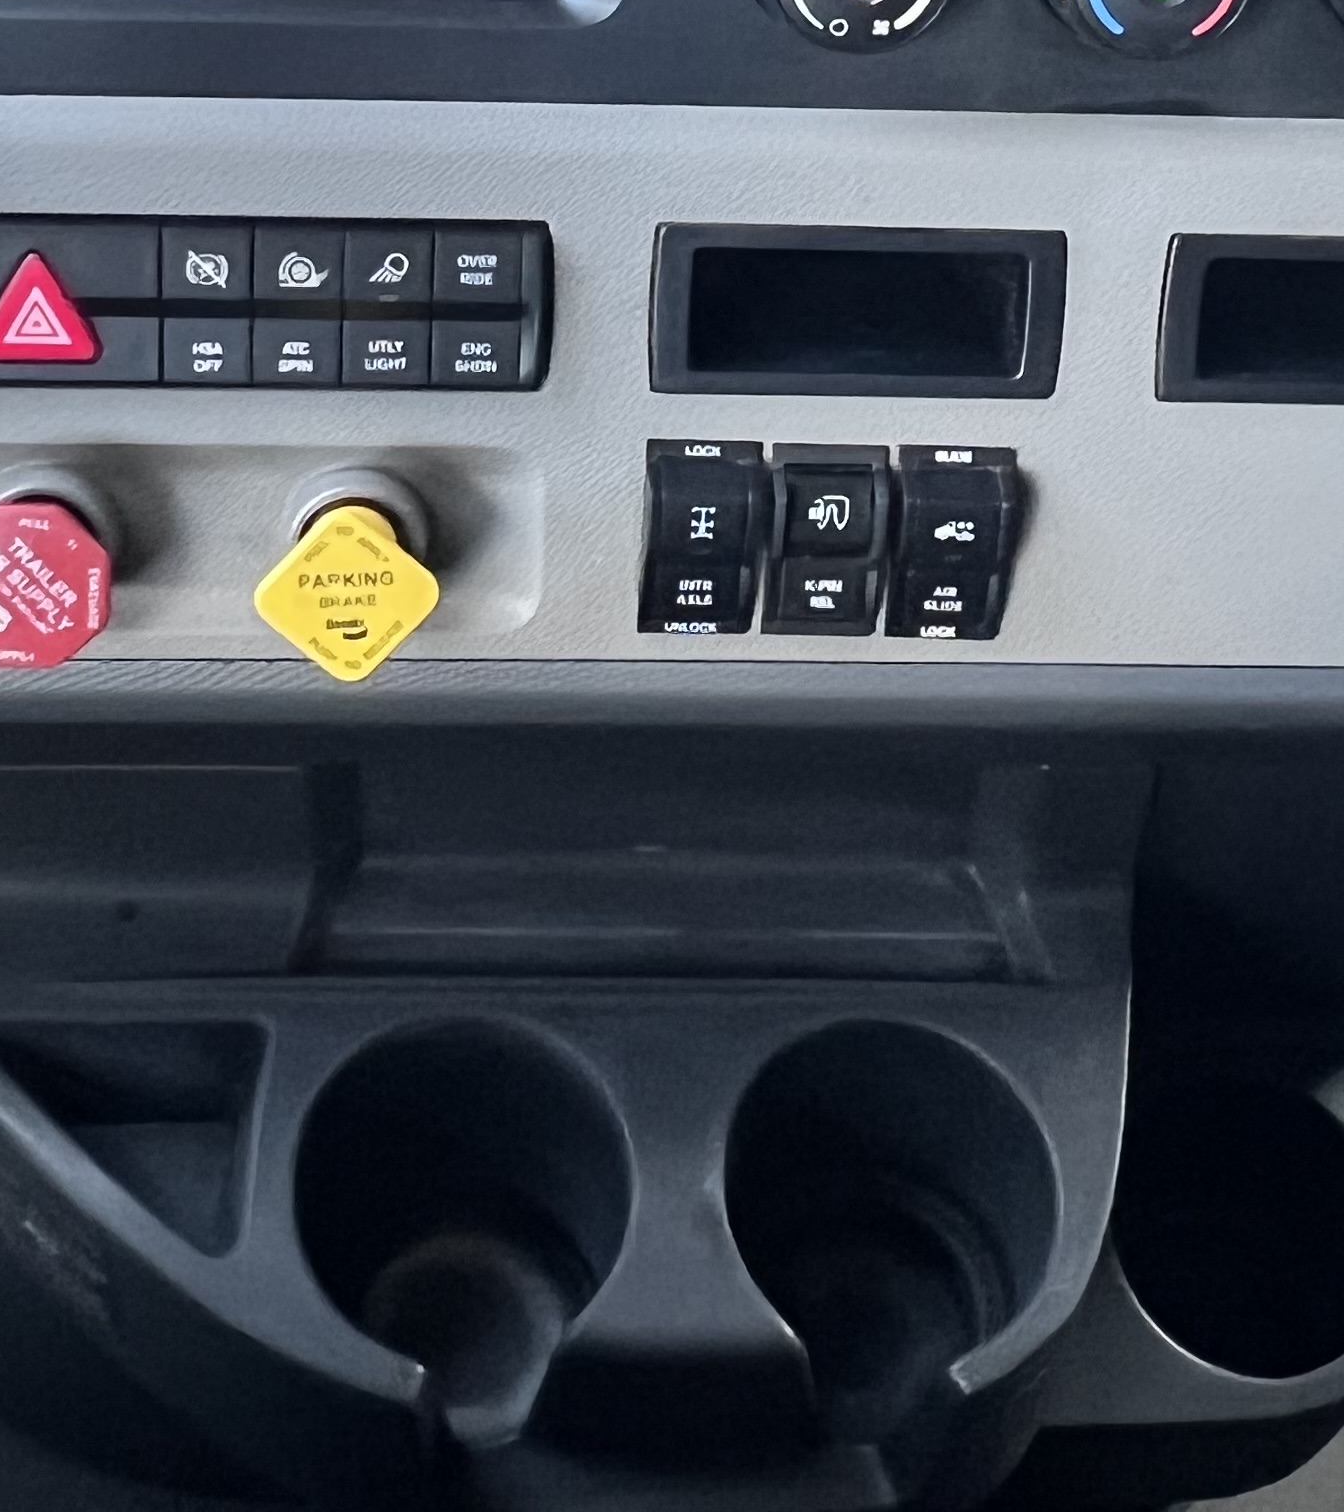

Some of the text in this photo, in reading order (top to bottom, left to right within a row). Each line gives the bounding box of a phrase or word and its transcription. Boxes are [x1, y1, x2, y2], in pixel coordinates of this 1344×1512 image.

[456, 254, 498, 268] OVER
[281, 340, 311, 355] ATC
[367, 339, 405, 354] UTLY
[460, 342, 492, 356] ENG
[192, 358, 224, 373] OFF
[364, 356, 407, 372] LIGHT
[684, 445, 722, 458] LOCK
[8, 536, 78, 608] TRAILER
[298, 571, 395, 590] PARKING
[6, 568, 75, 631] SUPPLY
[318, 593, 378, 609] BRAKE
[919, 625, 957, 639] LOCK
